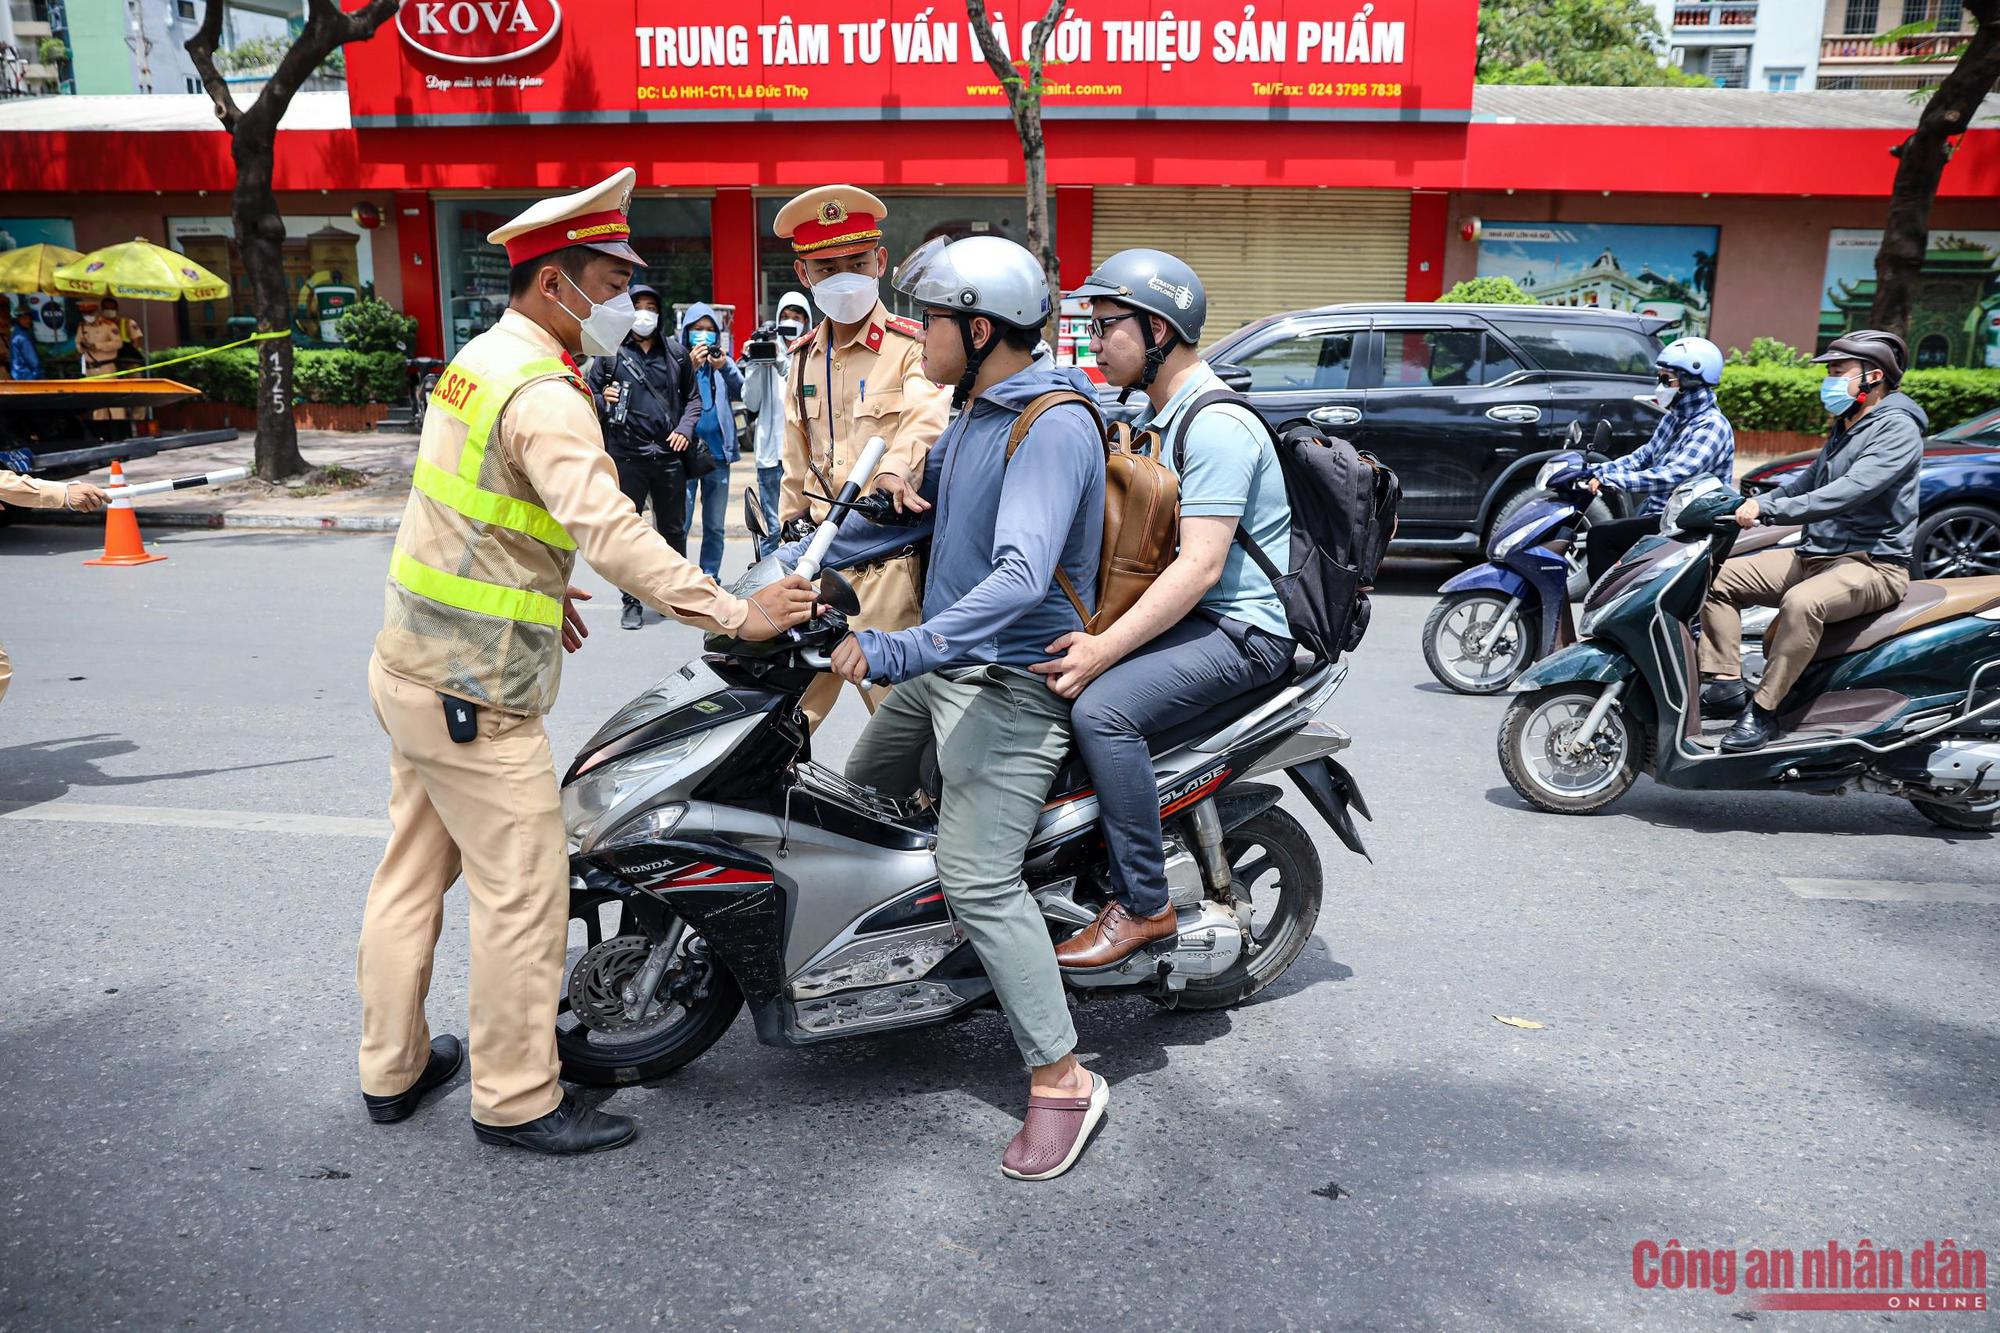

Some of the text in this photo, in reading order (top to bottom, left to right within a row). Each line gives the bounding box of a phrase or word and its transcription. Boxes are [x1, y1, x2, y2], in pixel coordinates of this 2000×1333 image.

[416, 0, 538, 34] KOVA
[635, 25, 749, 67] TRUNG
[757, 15, 829, 65] TÂM
[838, 18, 886, 64] TƯ
[891, 7, 958, 63] VẤN
[1102, 10, 1201, 72] THIỆU
[1212, 4, 1287, 63] SẢN
[1296, 2, 1405, 63] PHẨM
[425, 74, 451, 92] Đẹp
[519, 75, 543, 91] gian
[1252, 81, 1402, 97] Tel/Fax: 024 3795 7838
[637, 84, 808, 100] ĐC: Lô HH1-CT1, Lê Đức Thọ
[1149, 283, 1175, 299] EXPLORE
[1159, 763, 1226, 806] BLADE
[620, 859, 675, 875] HONDA
